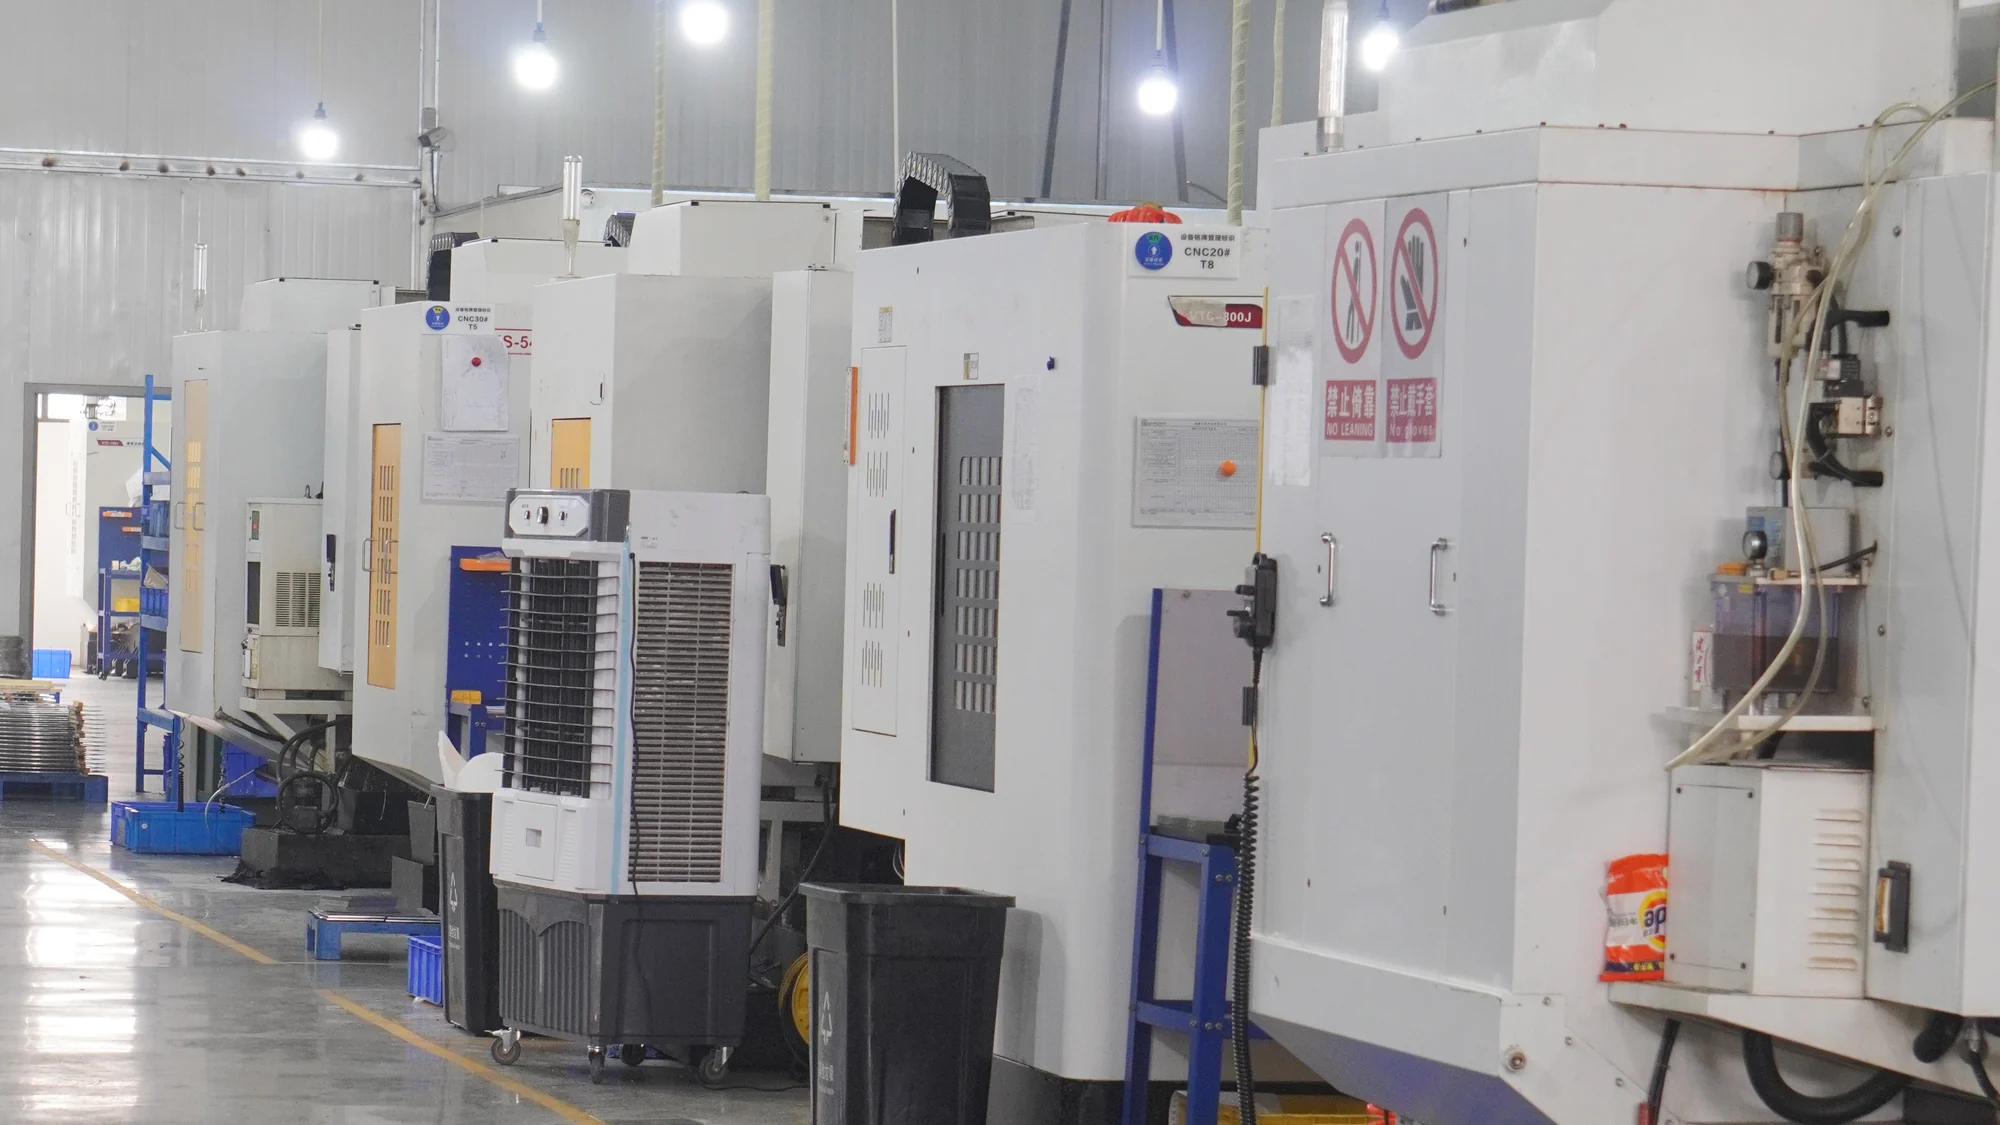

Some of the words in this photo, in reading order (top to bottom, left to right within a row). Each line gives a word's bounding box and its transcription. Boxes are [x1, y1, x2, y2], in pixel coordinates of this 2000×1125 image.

[1184, 247, 1231, 257] CNC20#
[1200, 260, 1214, 269] T8
[1327, 384, 1375, 418] 禁止倚靠
[1390, 383, 1434, 417] 禁止戴手套
[1326, 422, 1338, 436] NO
[1341, 422, 1373, 437] LEANING
[1390, 424, 1401, 437] No
